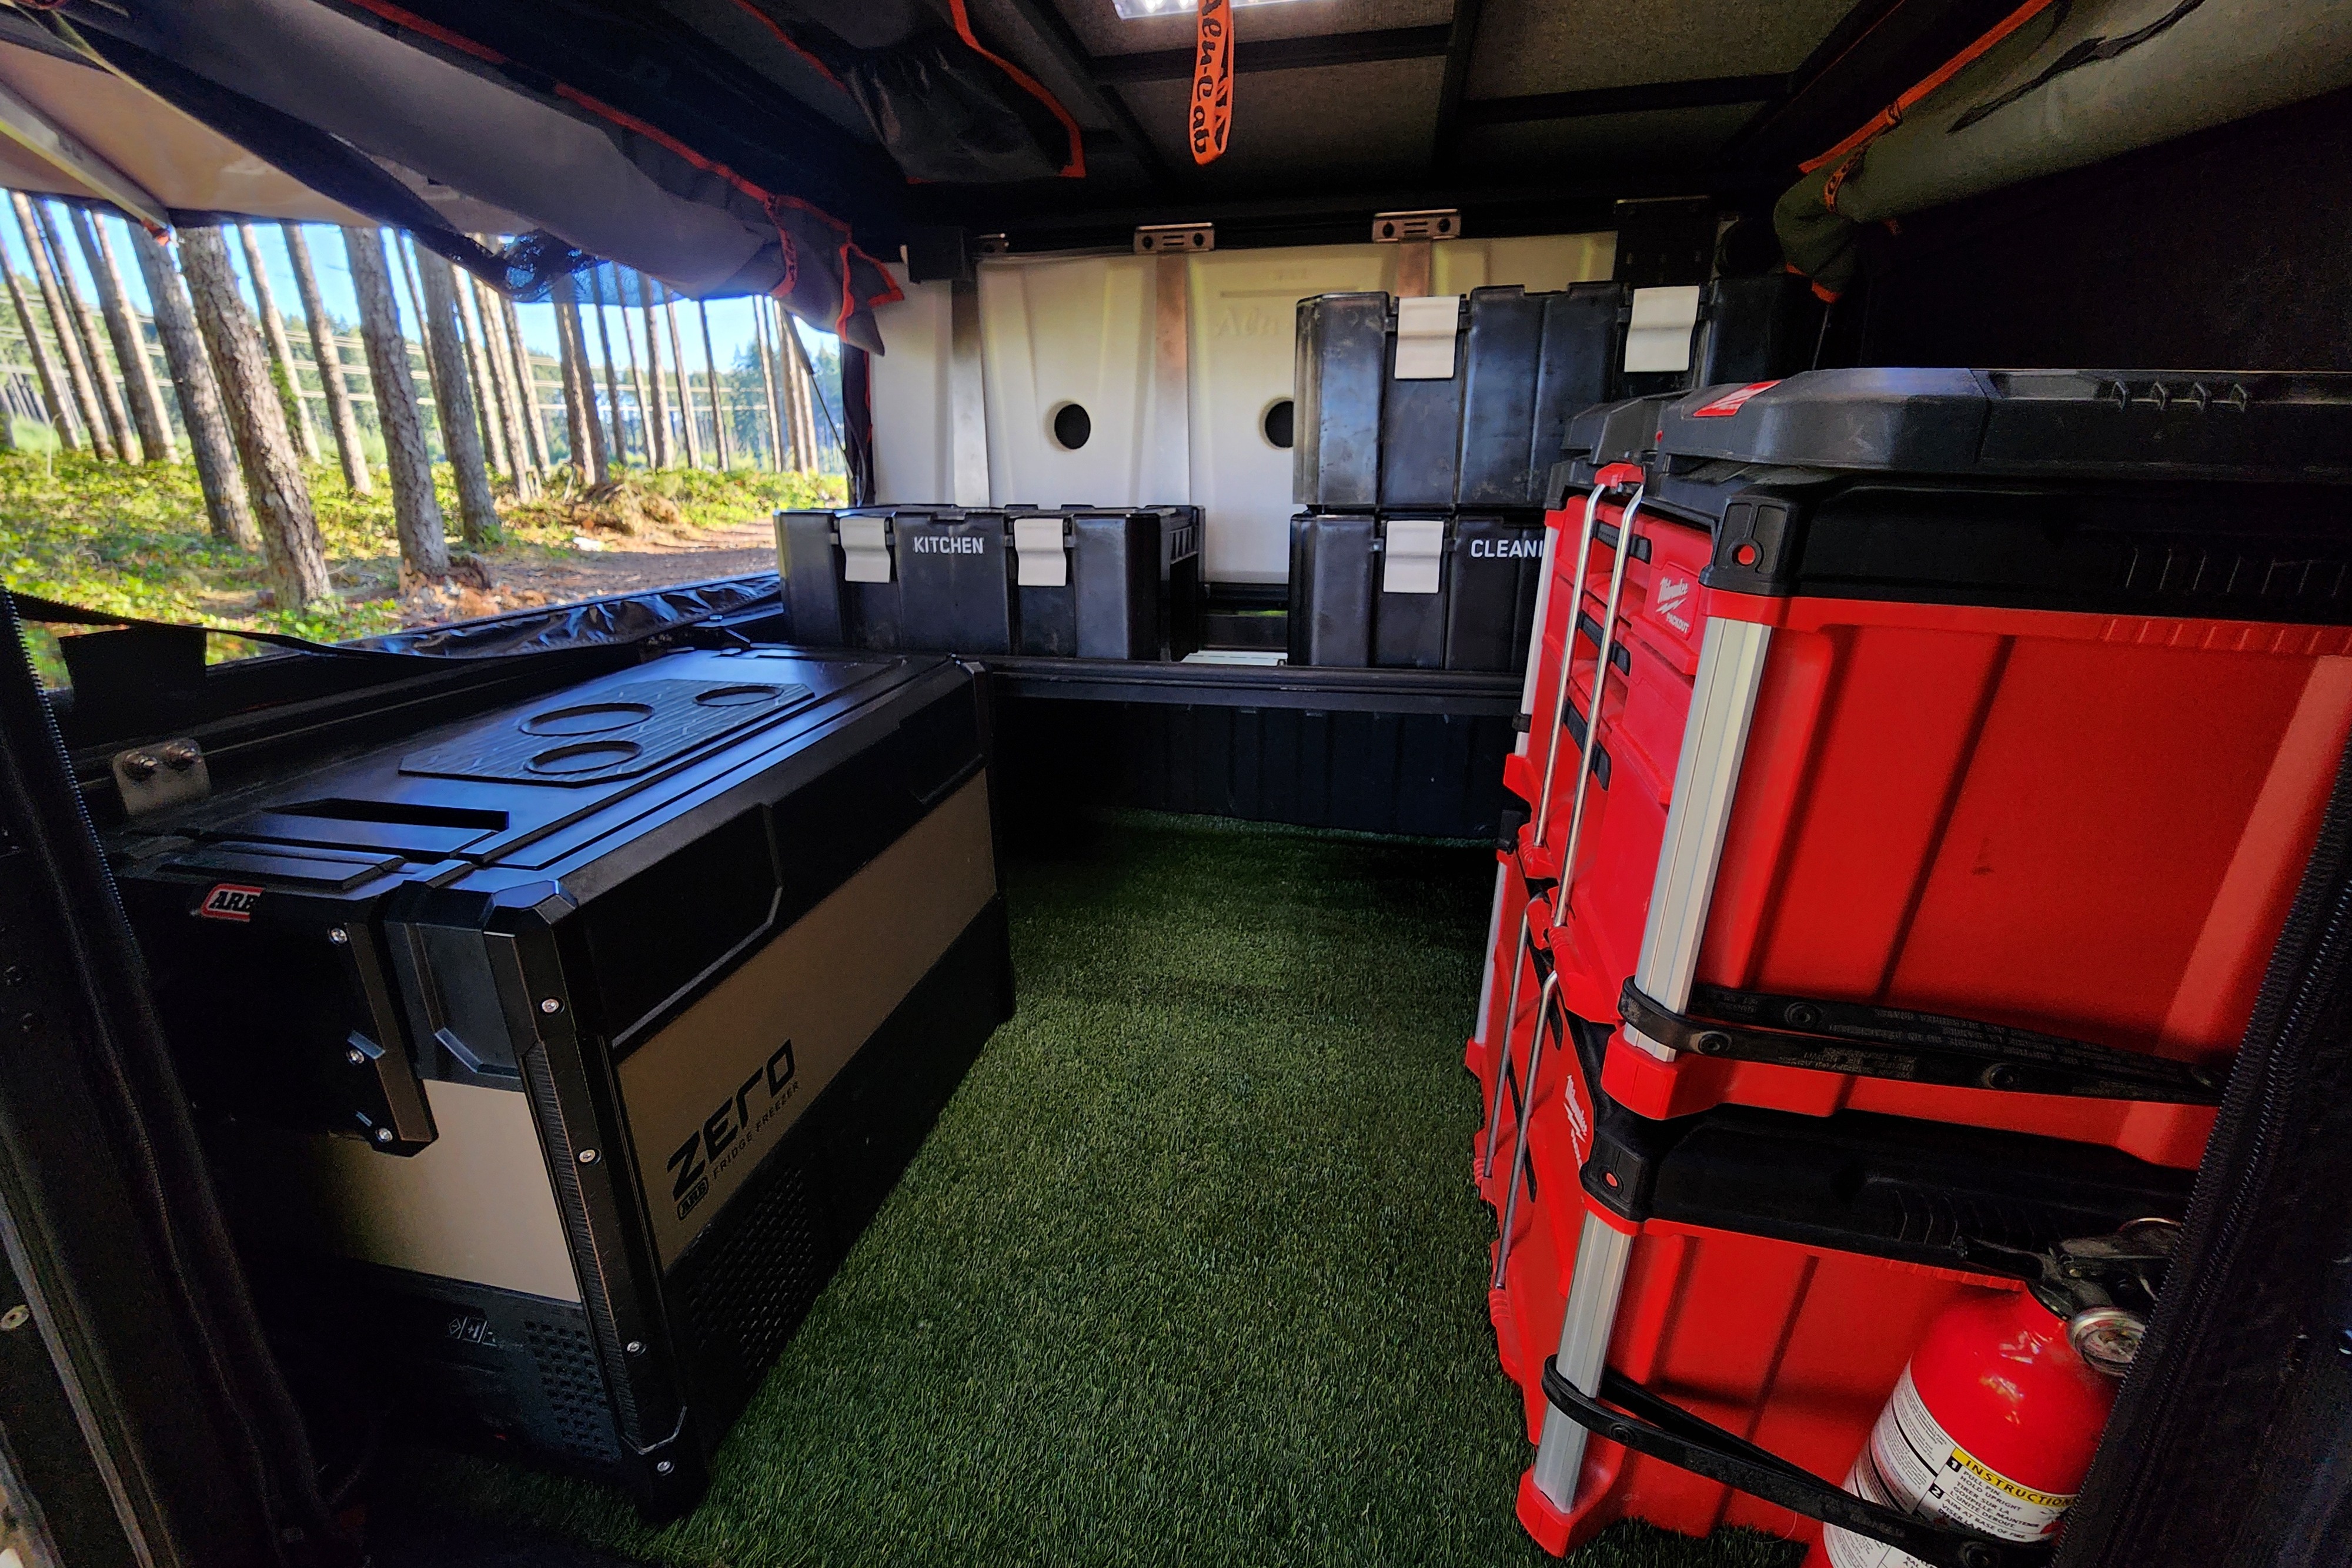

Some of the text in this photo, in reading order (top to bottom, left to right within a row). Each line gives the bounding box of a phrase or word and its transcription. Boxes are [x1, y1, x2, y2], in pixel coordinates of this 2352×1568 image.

[914, 536, 983, 554] KITCHEN
[712, 1080, 799, 1179] FRIDGE FREEZER
[1963, 1471, 1983, 1487] PULL
[1931, 1486, 1941, 1497] 2
[1957, 1481, 1979, 1499] TIRER
[1981, 1498, 1997, 1509] SUR
[1960, 1475, 2022, 1512] HOLD UPRIGHT
[1942, 1503, 1963, 1520] VISER
[1945, 1499, 1961, 1511] AIM
[1975, 1517, 1996, 1530] BASE
